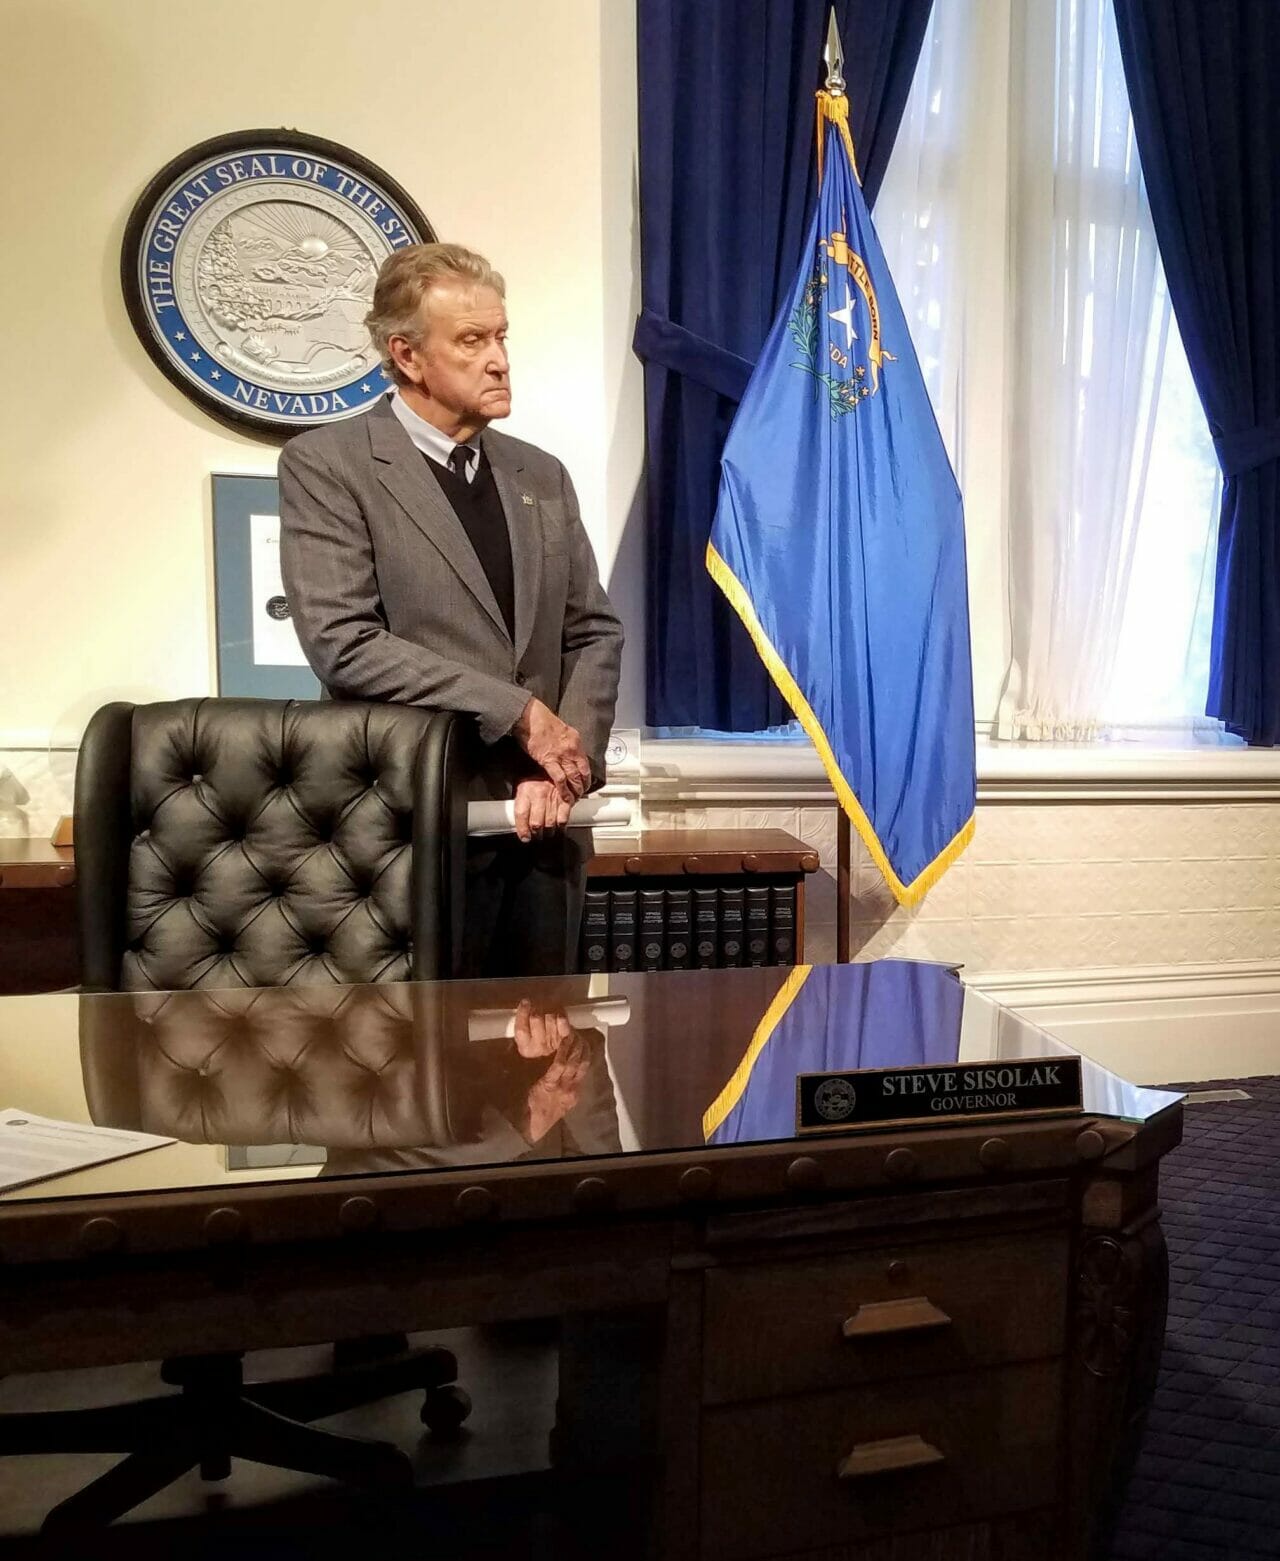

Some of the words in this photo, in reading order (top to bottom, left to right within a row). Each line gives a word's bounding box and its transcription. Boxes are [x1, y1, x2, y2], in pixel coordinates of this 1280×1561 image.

[215, 156, 286, 186] SEAL
[292, 159, 328, 183] OF
[336, 170, 387, 219] THE
[154, 176, 213, 254] GREAT
[148, 260, 173, 314] THE
[231, 381, 349, 416] NEVADA
[882, 1072, 956, 1096] STEVE
[963, 1066, 1062, 1090] SISOLAK
[931, 1092, 1017, 1112] GOVERNOR
